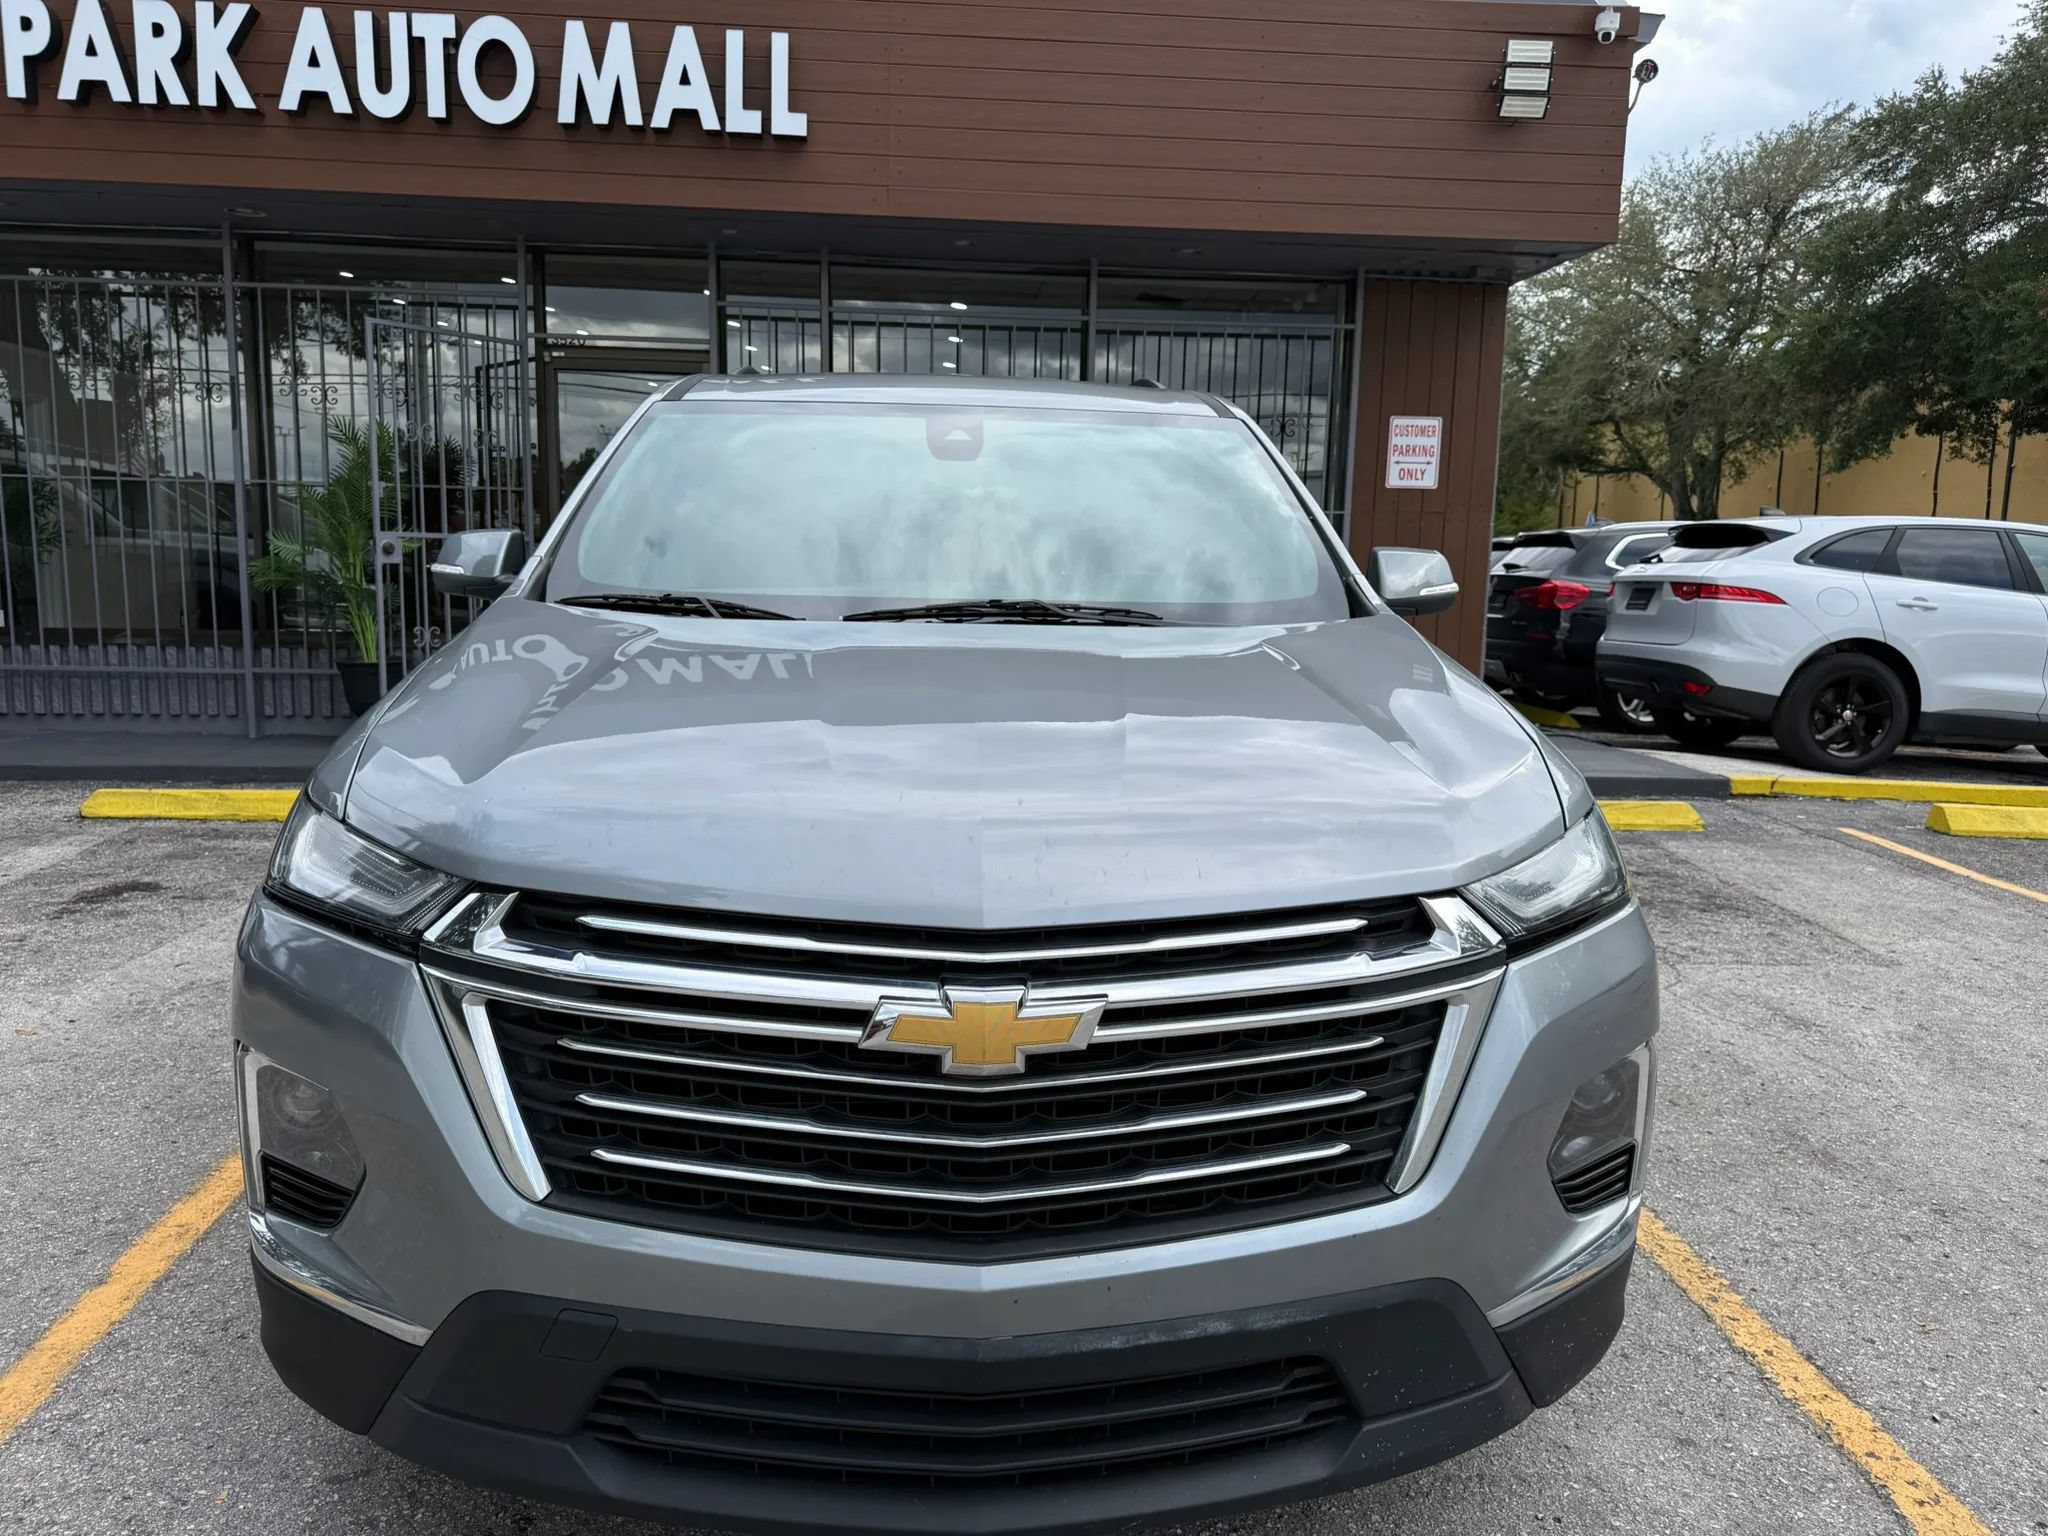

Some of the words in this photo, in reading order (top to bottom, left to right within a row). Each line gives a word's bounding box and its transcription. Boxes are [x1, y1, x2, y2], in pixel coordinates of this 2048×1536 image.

[1, 0, 257, 109] PARK
[278, 6, 535, 125] AUTO
[557, 20, 808, 137] MALL
[1393, 424, 1437, 438] CUSTOMER
[1392, 444, 1435, 458] PARKING
[1398, 468, 1426, 481] ONLY
